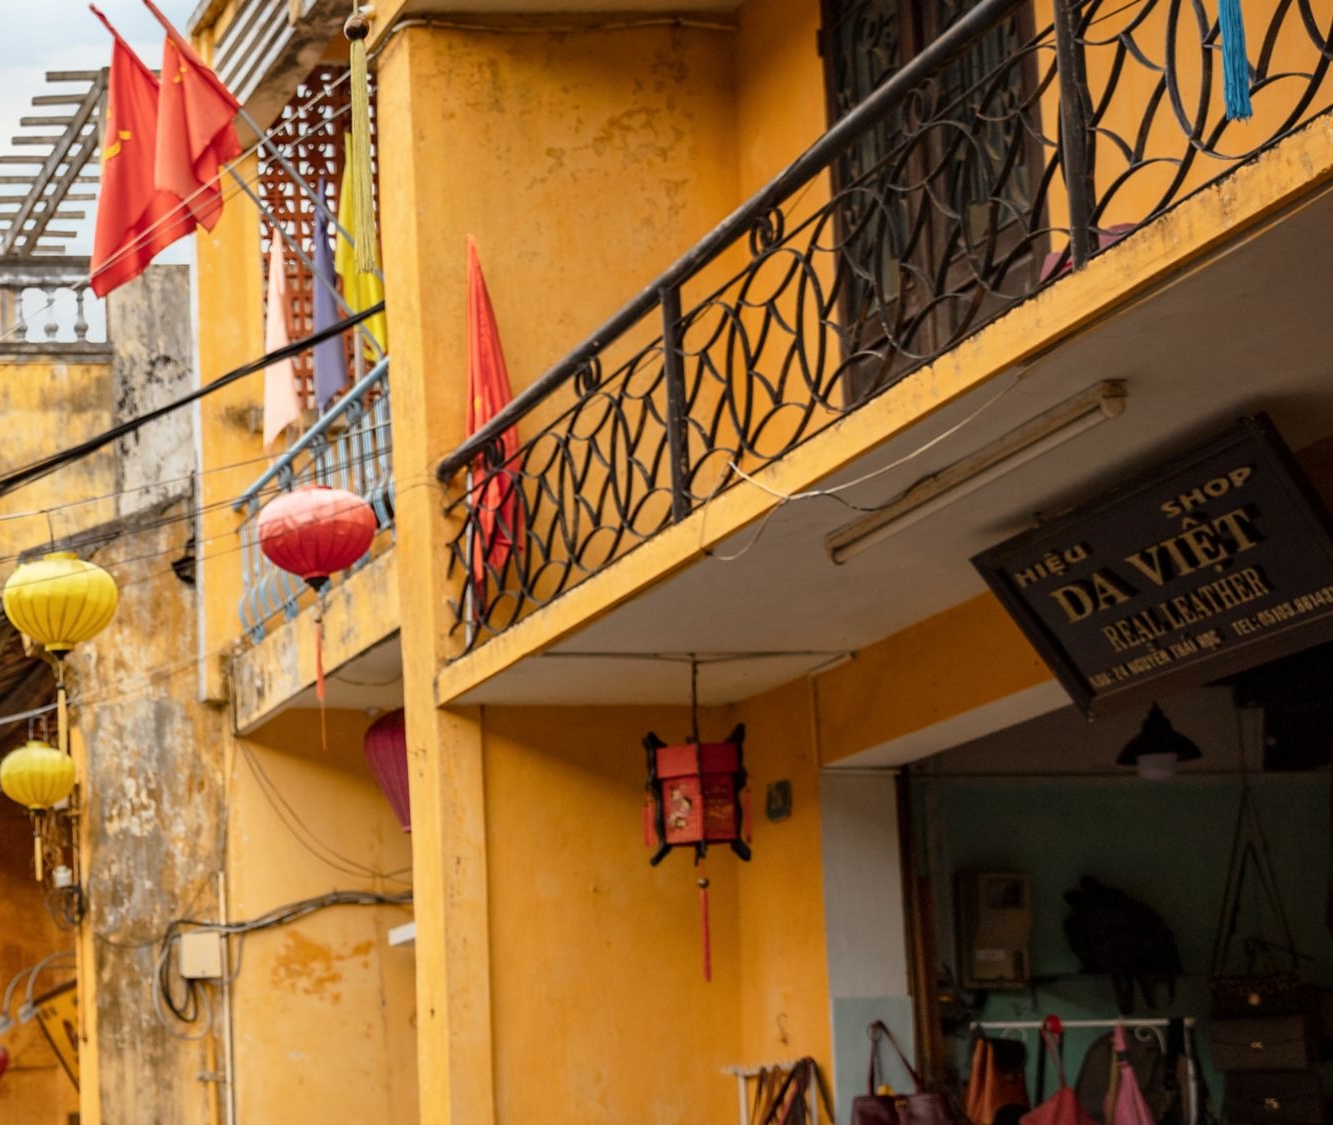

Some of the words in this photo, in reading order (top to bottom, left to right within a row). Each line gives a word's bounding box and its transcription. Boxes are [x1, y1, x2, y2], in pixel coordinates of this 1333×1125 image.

[1161, 466, 1253, 519] SHOP
[1049, 570, 1130, 624] DA
[1125, 509, 1259, 587] VIỆT
[1101, 611, 1167, 653] REAL
[1158, 567, 1270, 632] LEATHER
